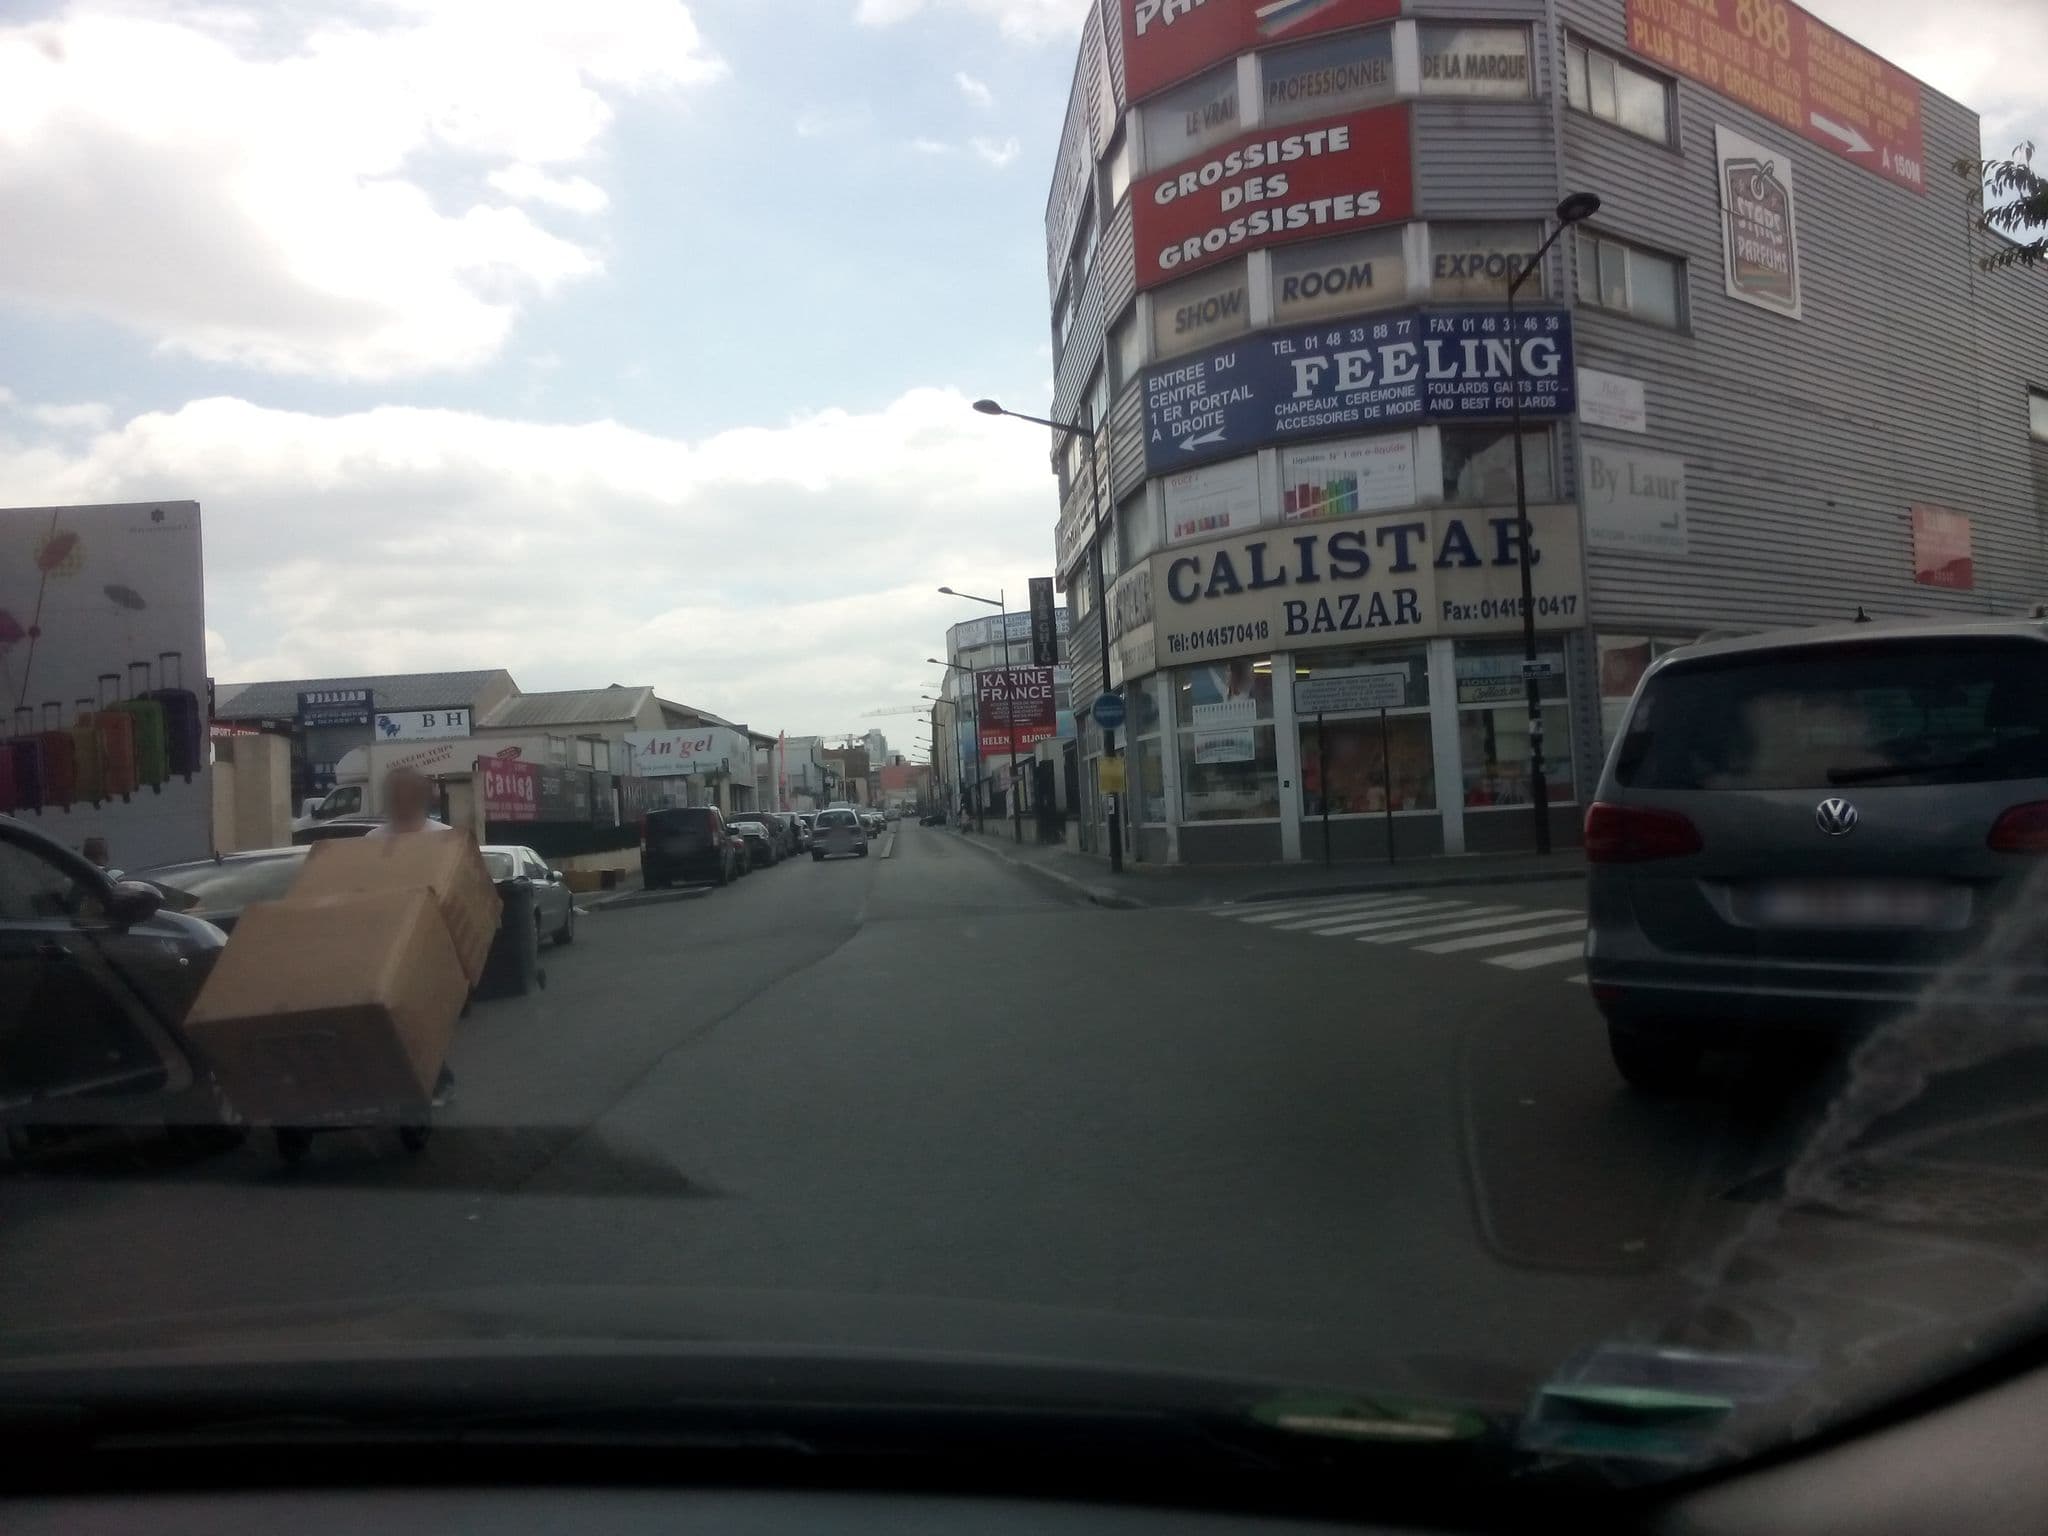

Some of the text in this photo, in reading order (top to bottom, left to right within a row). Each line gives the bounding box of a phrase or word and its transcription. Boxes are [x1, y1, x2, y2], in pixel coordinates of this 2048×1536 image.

[1423, 54, 1526, 80] DE LA MARQUE
[1632, 17, 1674, 62] PLUS
[1678, 38, 1699, 73] DE
[1701, 51, 1719, 83] 70
[1269, 58, 1387, 104] PROFESSIONNEL
[1186, 95, 1235, 137] LE VRAI
[1154, 126, 1350, 205] GROSSISTE
[1220, 173, 1289, 213] DES
[1158, 190, 1382, 270] GROSSISTES
[1281, 262, 1374, 302] ROOM
[1433, 252, 1540, 280] EXPORT
[1175, 287, 1244, 334] SHOW
[1272, 316, 1559, 356] TEL 01 48 33 88 77 FAX 01 48 3 46 36
[1149, 352, 1236, 393] ENTREE DU
[1291, 336, 1562, 398] FEELING
[1150, 380, 1207, 409] CENTRE
[1163, 405, 1182, 422] ER
[1190, 385, 1254, 415] PORTAIL
[1274, 396, 1338, 416] CHAPEAUX
[1345, 385, 1416, 406] CEREMONIE
[1428, 382, 1489, 395] FOULARDS
[1494, 380, 1532, 393] GATS
[1275, 396, 1557, 431] ACCESSOIRES DE MODE AND BEST FOLARDS
[1152, 410, 1225, 443] A DROITE
[1590, 455, 1618, 503] By
[1167, 518, 1541, 604] CALISTAR
[1282, 588, 1422, 637] BAZAR
[980, 686, 1053, 702] FRANCE
[982, 671, 1048, 687] KARINE
[422, 712, 463, 728] B H
